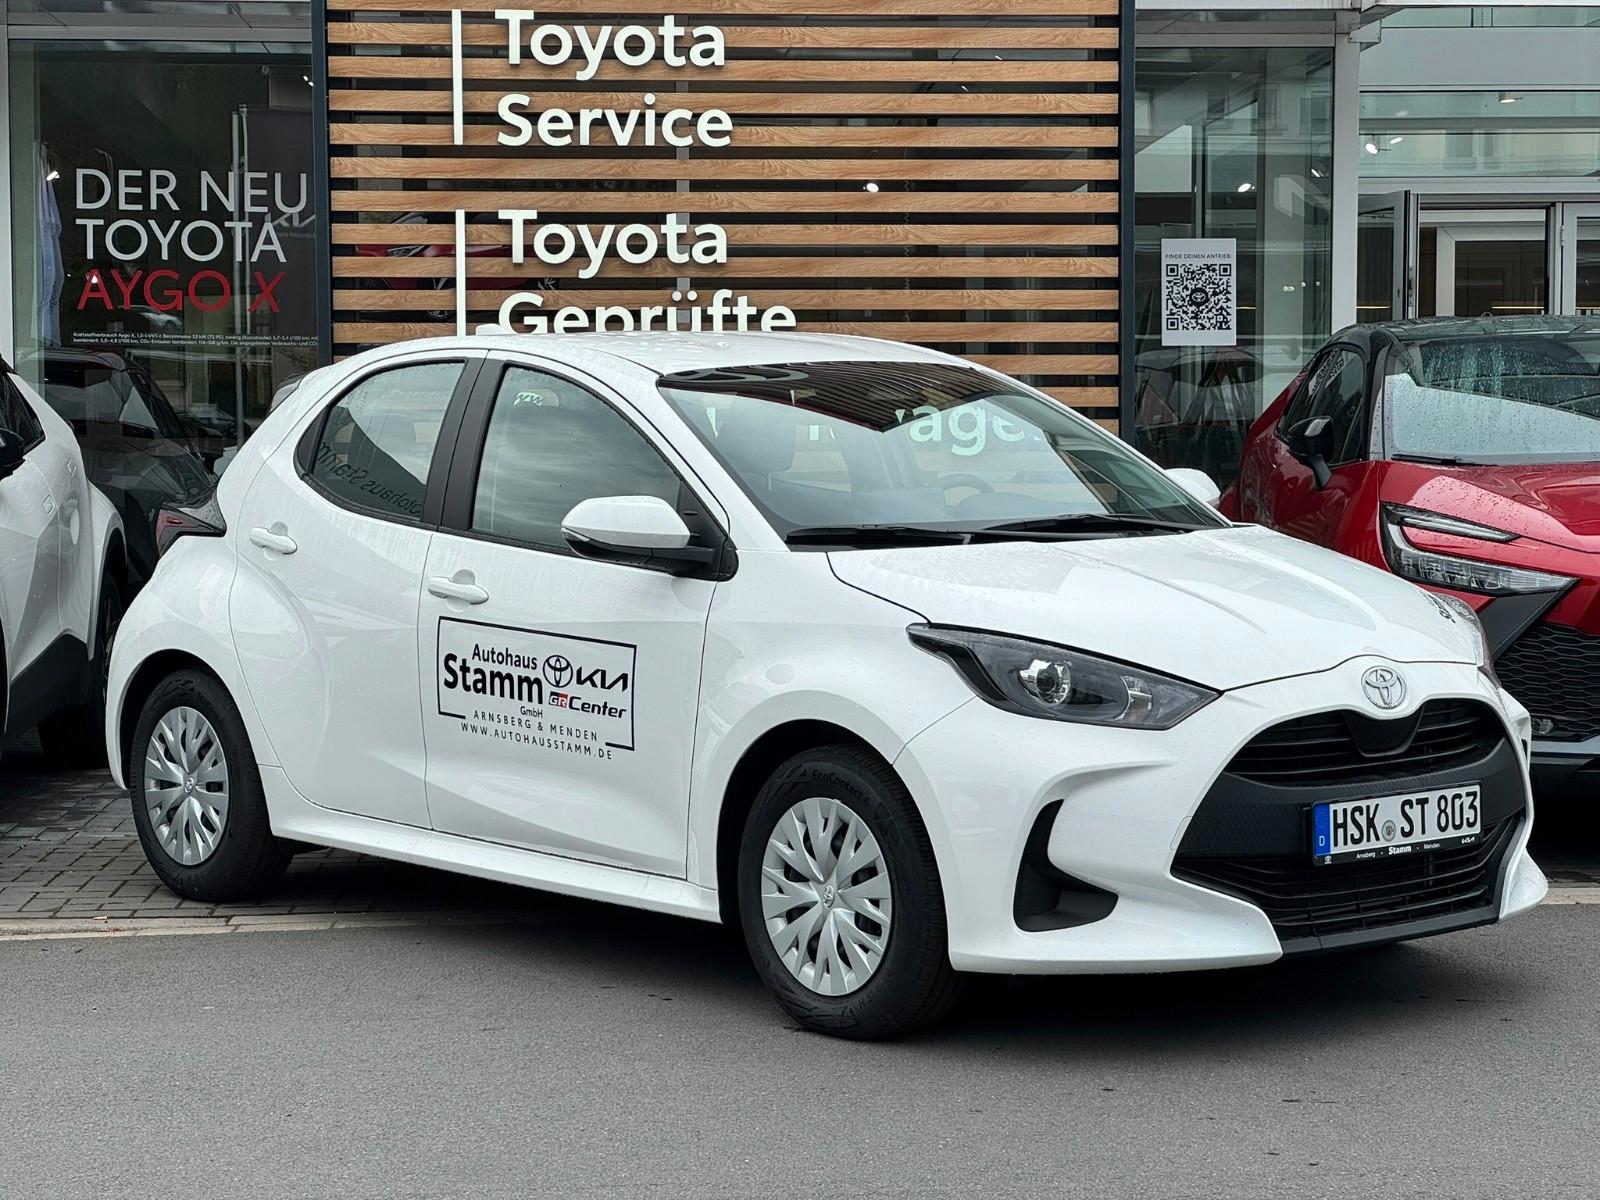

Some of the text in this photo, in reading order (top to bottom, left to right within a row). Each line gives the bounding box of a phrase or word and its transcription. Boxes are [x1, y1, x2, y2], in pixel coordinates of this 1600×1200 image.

[495, 9, 725, 81] Toyota
[497, 93, 733, 147] Service
[76, 168, 307, 214] DER NEU
[76, 219, 287, 262] TOYOTA
[498, 209, 727, 279] Toyota
[77, 269, 231, 313] AYGO
[250, 271, 285, 313] X
[472, 643, 538, 670] Autohaus
[443, 653, 544, 705] Stamm
[473, 710, 598, 742] ARNSBERG & MENDEN
[520, 706, 543, 718] GmbH
[549, 692, 627, 719] GR Center
[461, 722, 612, 760] WWW.AUTOHAUSSTAMM.DE
[1318, 790, 1478, 848] D HSK ST 803
[1388, 845, 1412, 855] Stamm
